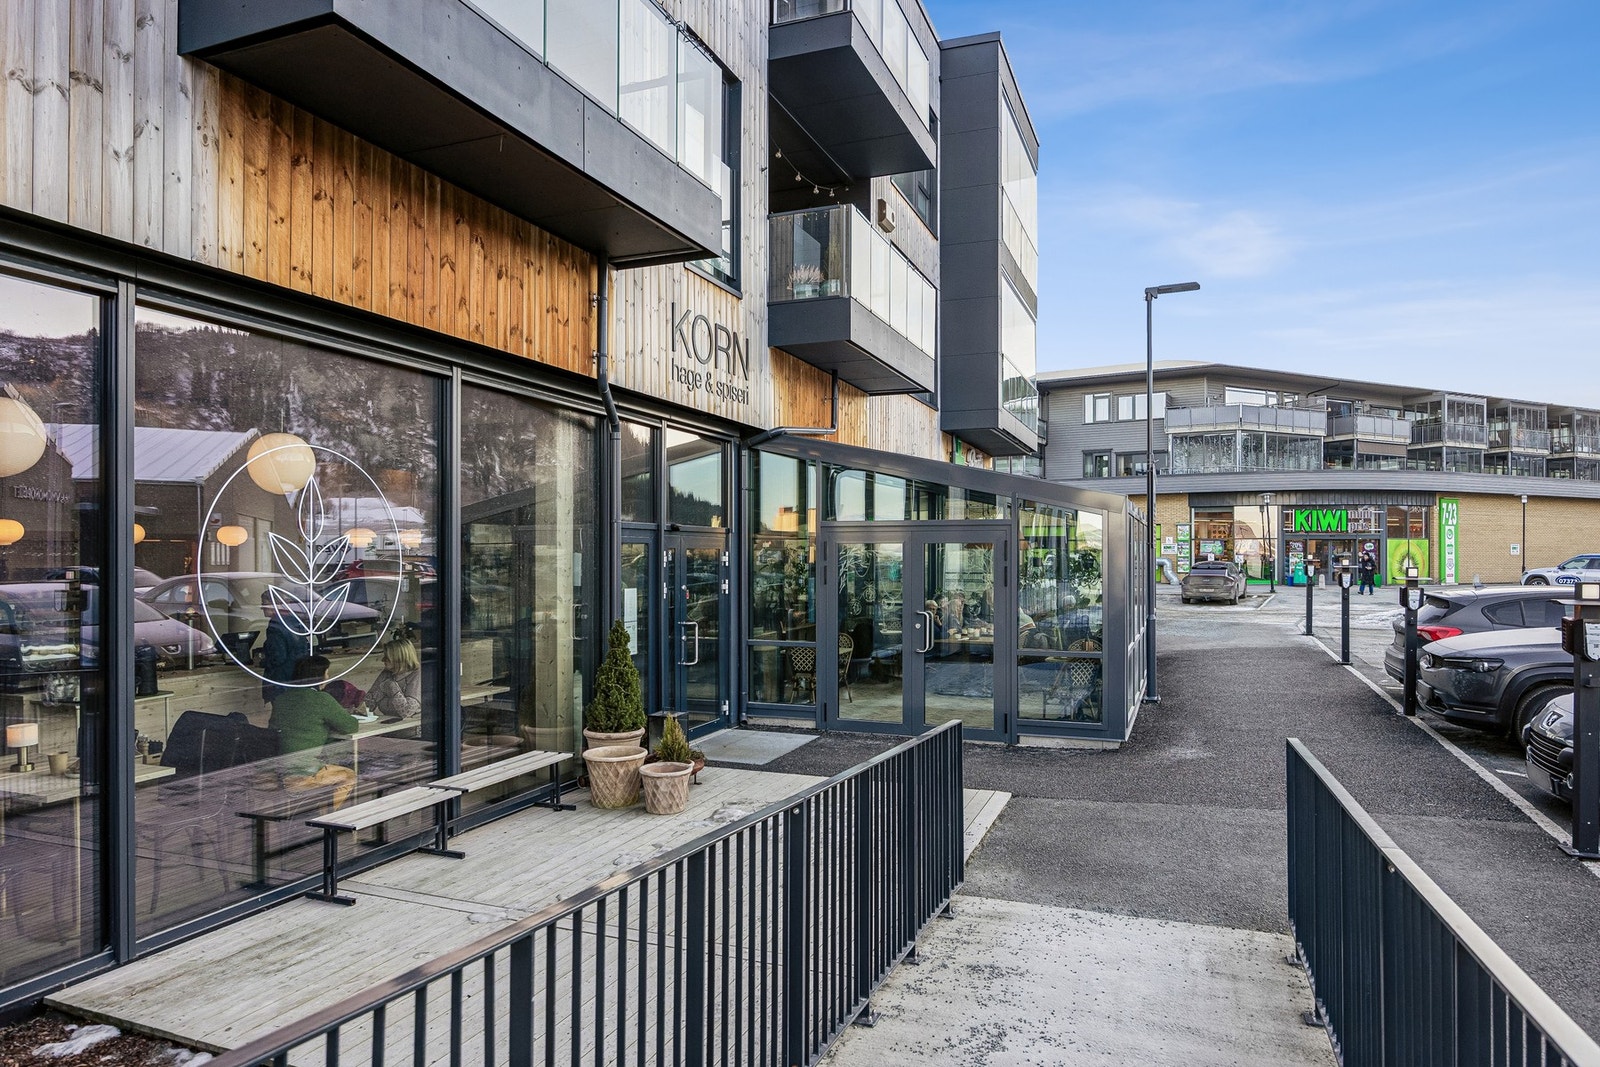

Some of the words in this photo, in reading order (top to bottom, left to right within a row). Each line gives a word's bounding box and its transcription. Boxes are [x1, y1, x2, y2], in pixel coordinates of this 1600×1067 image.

[672, 302, 749, 381] KORN
[672, 358, 702, 392] hage
[705, 371, 713, 394] &
[716, 379, 749, 405] spiseri
[1295, 509, 1348, 532] KIWI
[1442, 503, 1457, 525] 7-23
